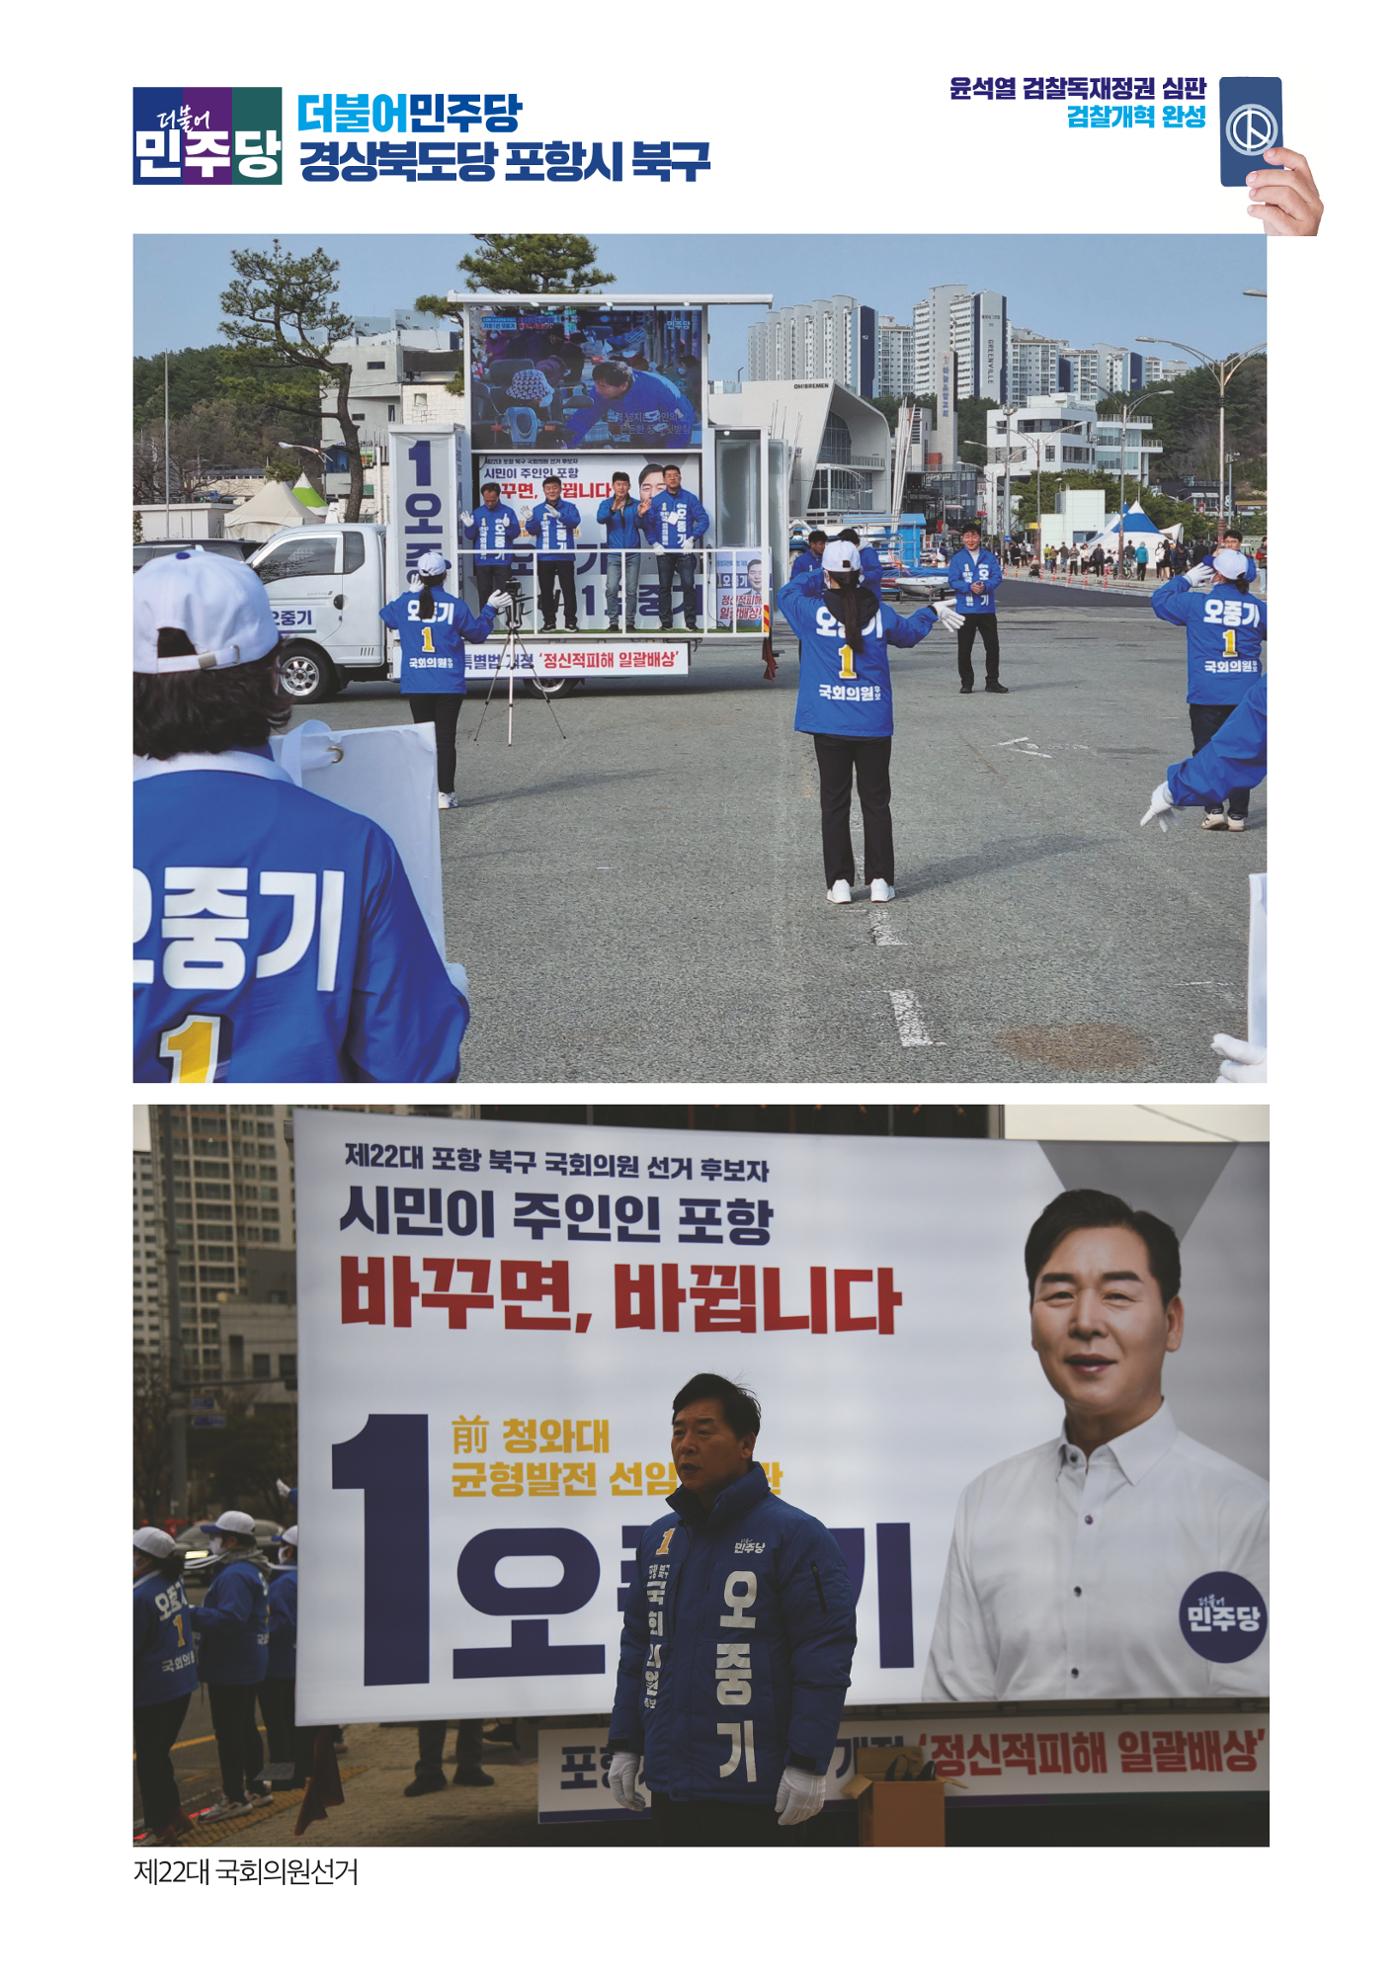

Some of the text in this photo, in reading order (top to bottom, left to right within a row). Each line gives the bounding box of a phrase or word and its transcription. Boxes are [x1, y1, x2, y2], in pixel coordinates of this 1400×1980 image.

[950, 77, 1207, 100] 윤석열 검찰독재정권 심판
[157, 104, 210, 133] 더불어
[298, 93, 523, 133] 더불어민주당
[1067, 105, 1206, 129] 검찰개혁 완성
[136, 129, 282, 178] 민주당
[299, 140, 711, 182] 경상북도당 포항시 북구
[408, 440, 431, 486] 1
[484, 467, 517, 479] 시민이
[557, 467, 579, 479] 포항
[501, 482, 612, 499] 꾸면, 뀝니다
[816, 606, 883, 638] 오기
[1203, 599, 1261, 628] 오중기
[421, 626, 436, 652] 1
[1222, 629, 1238, 657] 1
[838, 643, 857, 680] 1
[132, 867, 345, 992] 중기
[159, 1014, 221, 1084] 1
[345, 1142, 770, 1183] 제22대 포항 북구 국회의원 선거 후보자
[339, 1185, 774, 1246] 시민이 주인인 포항
[340, 1254, 903, 1336] 바꾸면, 바뀝니다
[451, 1414, 609, 1456] 前 청와대
[451, 1462, 597, 1498] 균형발전
[331, 1413, 430, 1687] 1
[655, 1527, 676, 1555] 1
[172, 1614, 187, 1648] 1
[1187, 1606, 1261, 1632] 민주당
[714, 1570, 758, 1783] 오중기
[133, 1858, 358, 1885] 제22대 국회의원선거
